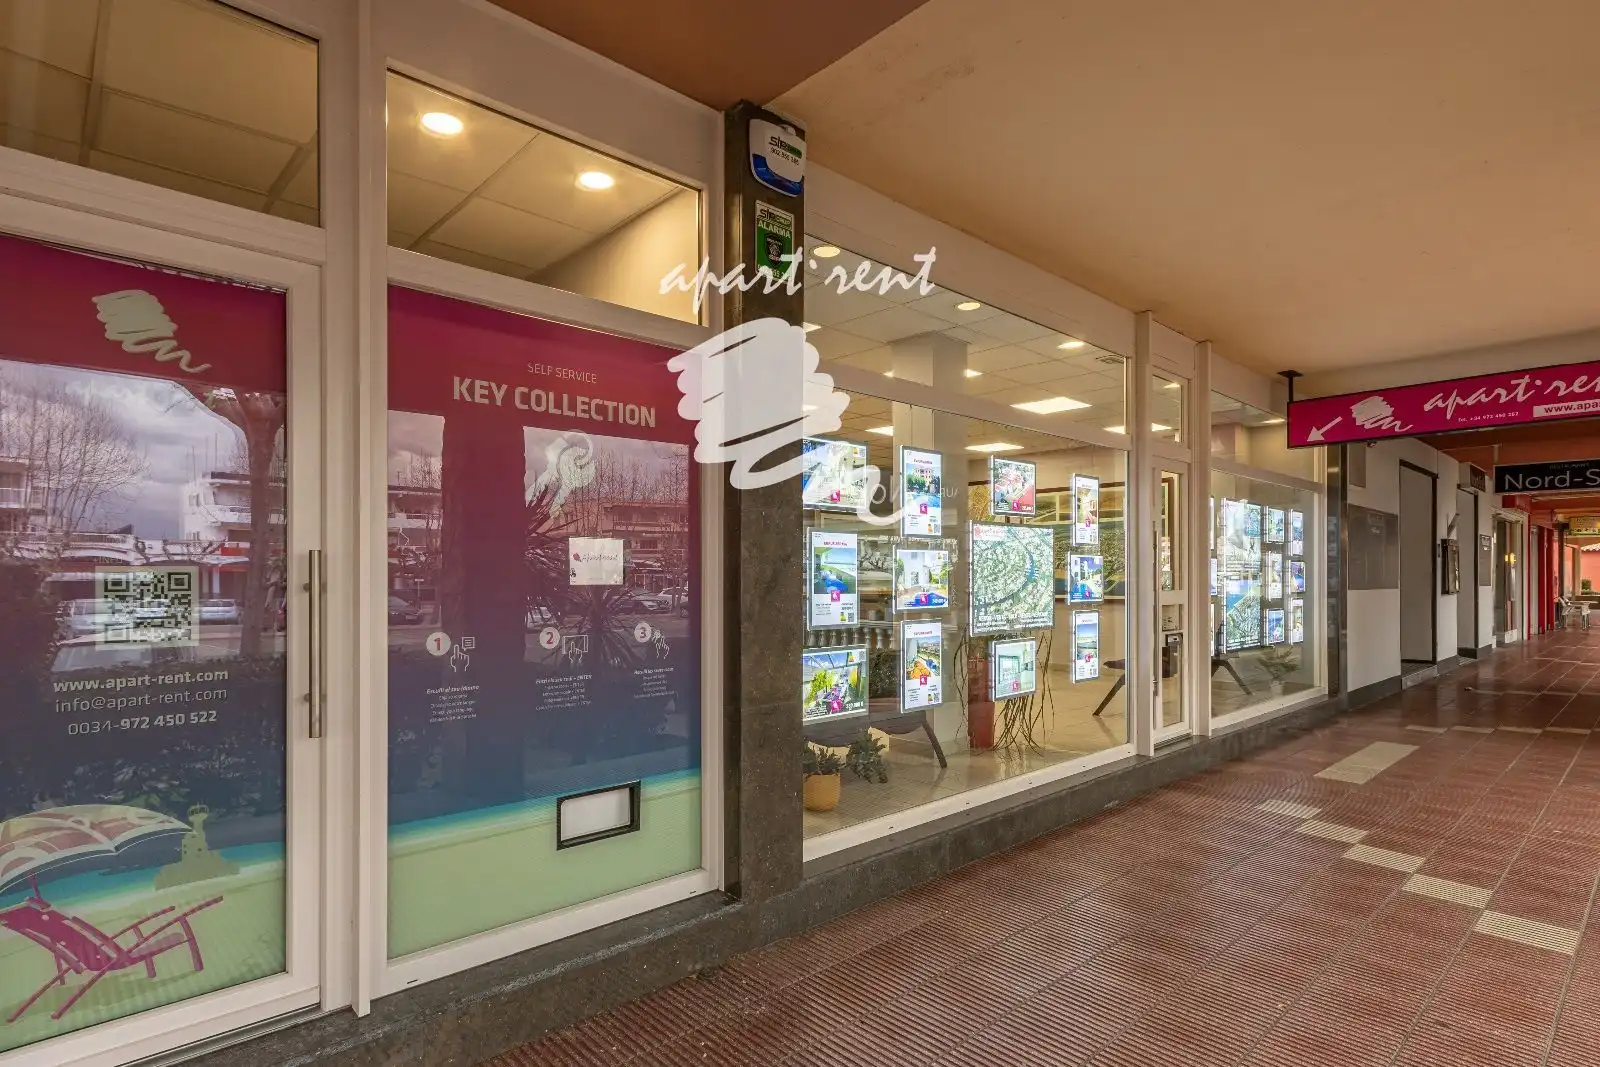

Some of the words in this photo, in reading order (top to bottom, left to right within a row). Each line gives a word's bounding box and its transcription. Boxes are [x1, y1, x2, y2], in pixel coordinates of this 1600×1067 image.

[758, 220, 791, 239] ALARMA
[527, 362, 552, 375] SELF
[555, 367, 597, 384] SERVICE
[453, 376, 508, 406] KEY
[514, 386, 656, 428] COLLECTION
[53, 669, 229, 693] www.apart-rent.com
[55, 688, 227, 713] info@apart-rent.com
[68, 716, 150, 736] 0034-972
[153, 713, 185, 728] 450
[190, 710, 217, 724] 522
